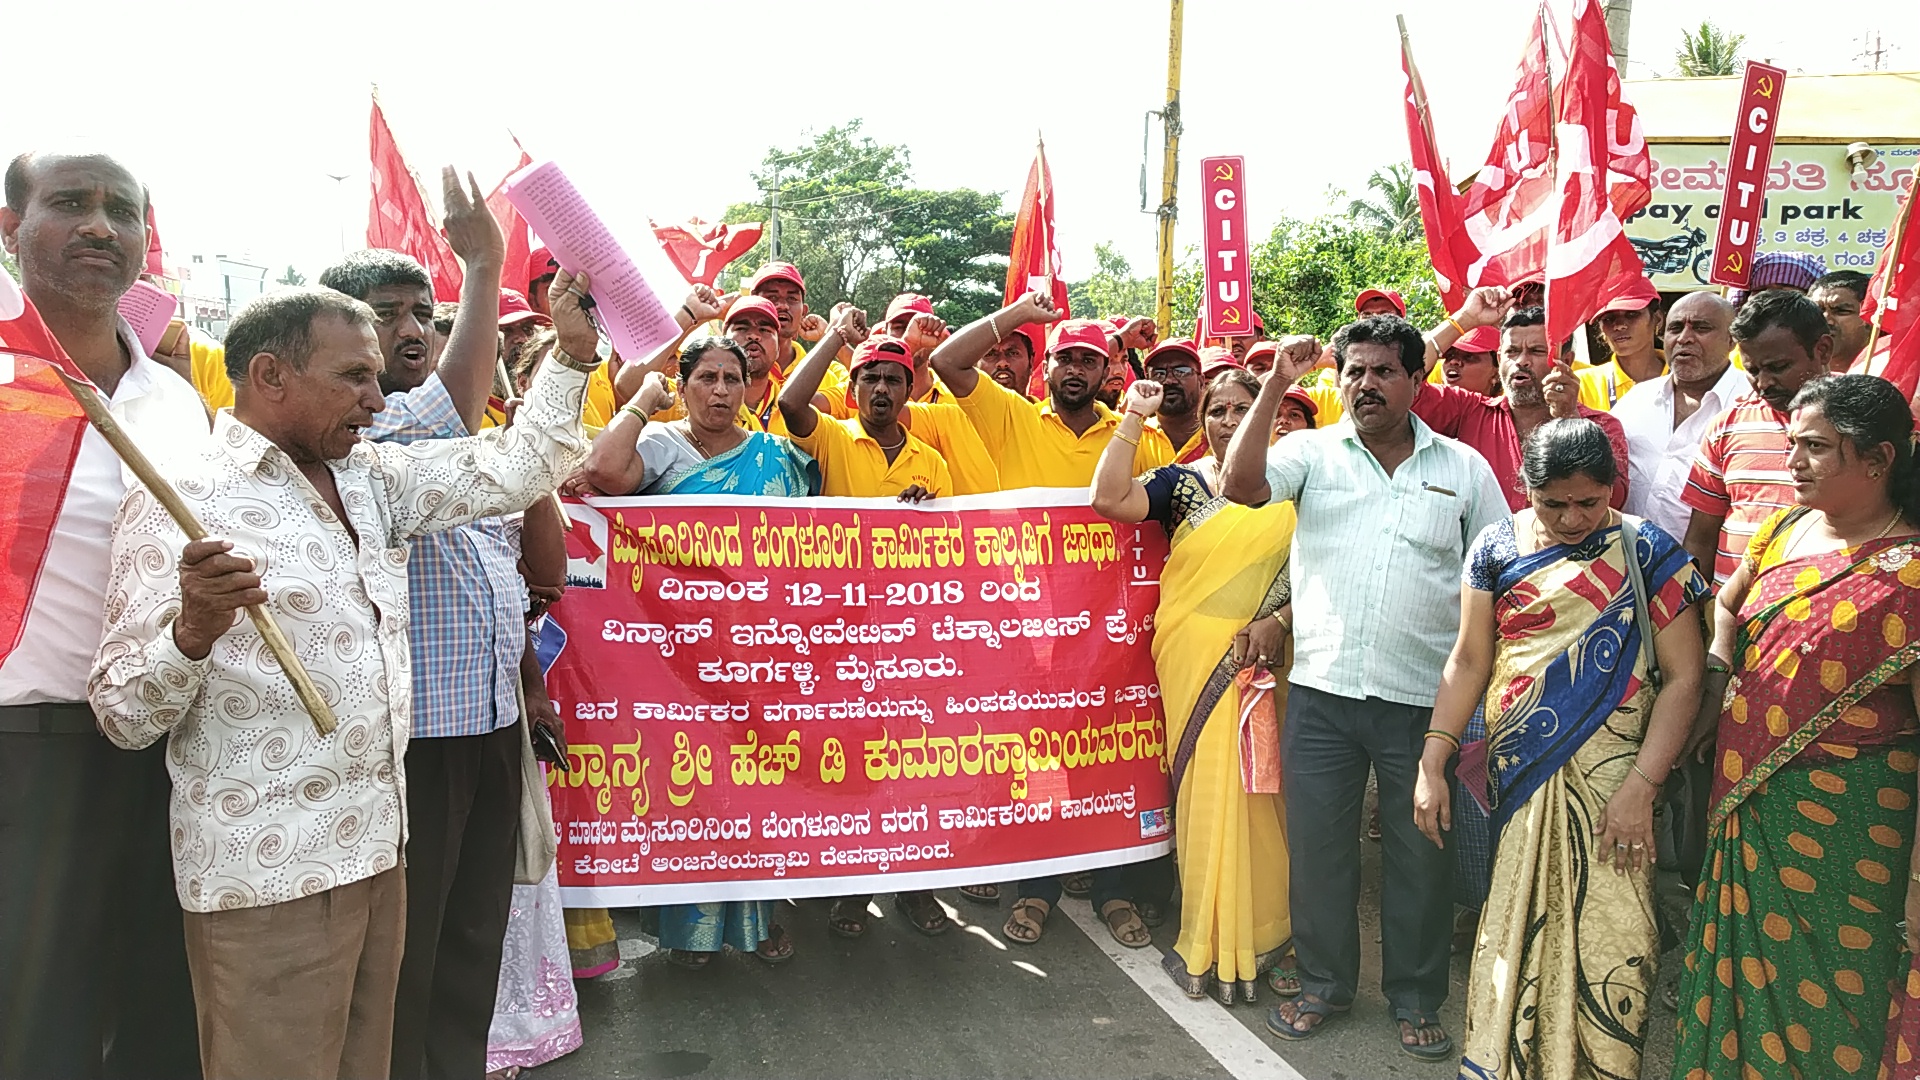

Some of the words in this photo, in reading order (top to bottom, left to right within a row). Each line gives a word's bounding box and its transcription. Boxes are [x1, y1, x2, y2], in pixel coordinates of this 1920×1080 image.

[1729, 106, 1769, 246] CITU
[1781, 197, 1863, 225] park
[1214, 188, 1240, 302] CITU
[1838, 232, 1849, 243] 4
[1834, 250, 1876, 267] ಗಂಟೆ
[612, 511, 742, 593] ಮೈಸೂರಿನಿಂದ
[752, 511, 861, 569] ಬೆಂಗಳೂರಿಗೆ
[871, 515, 964, 569] ಕಾರ್ಮಿಕರ
[659, 574, 769, 602] ದಿನಾಂಕ
[979, 575, 1041, 602] ರಿಂದ
[601, 617, 713, 658] ವಿನ್ಯಾಸ್
[730, 617, 917, 656] ಇನ್ನೋವೇಟಿವ್
[932, 610, 1091, 649] ಟೆಕ್ನಾಲಜೀಸ್
[835, 652, 964, 692] ಮೈಸೂರು.
[575, 697, 618, 720] ಜನ
[633, 699, 750, 722] ಕಾರ್ಮಿಕರ
[763, 694, 935, 724] ವರ್ಗಾವಣೆಯನ್ನು
[946, 685, 1106, 714] ಹಿಂಪಡೆಯುವಂತೆ
[667, 731, 713, 807] ಶ್ರೀ
[730, 729, 801, 786] ಹೆಚ್
[820, 738, 846, 784] ಡಿ
[568, 814, 617, 845] ಮಾಡಲು
[621, 812, 751, 856] ಮೈಸೂರಿನಿಂದ
[761, 807, 871, 839] ಬೆಂಗಳೂರಿನ
[938, 795, 1053, 831] ಕಾರ್ಮಿಕರಿಂದ
[1060, 784, 1137, 819] ಪಾದಯಾತ್ರೆ
[574, 854, 640, 874] ಕೋಟೆ
[651, 849, 811, 877] ಆಂಜನೇಯಸ್ವಾಮಿ
